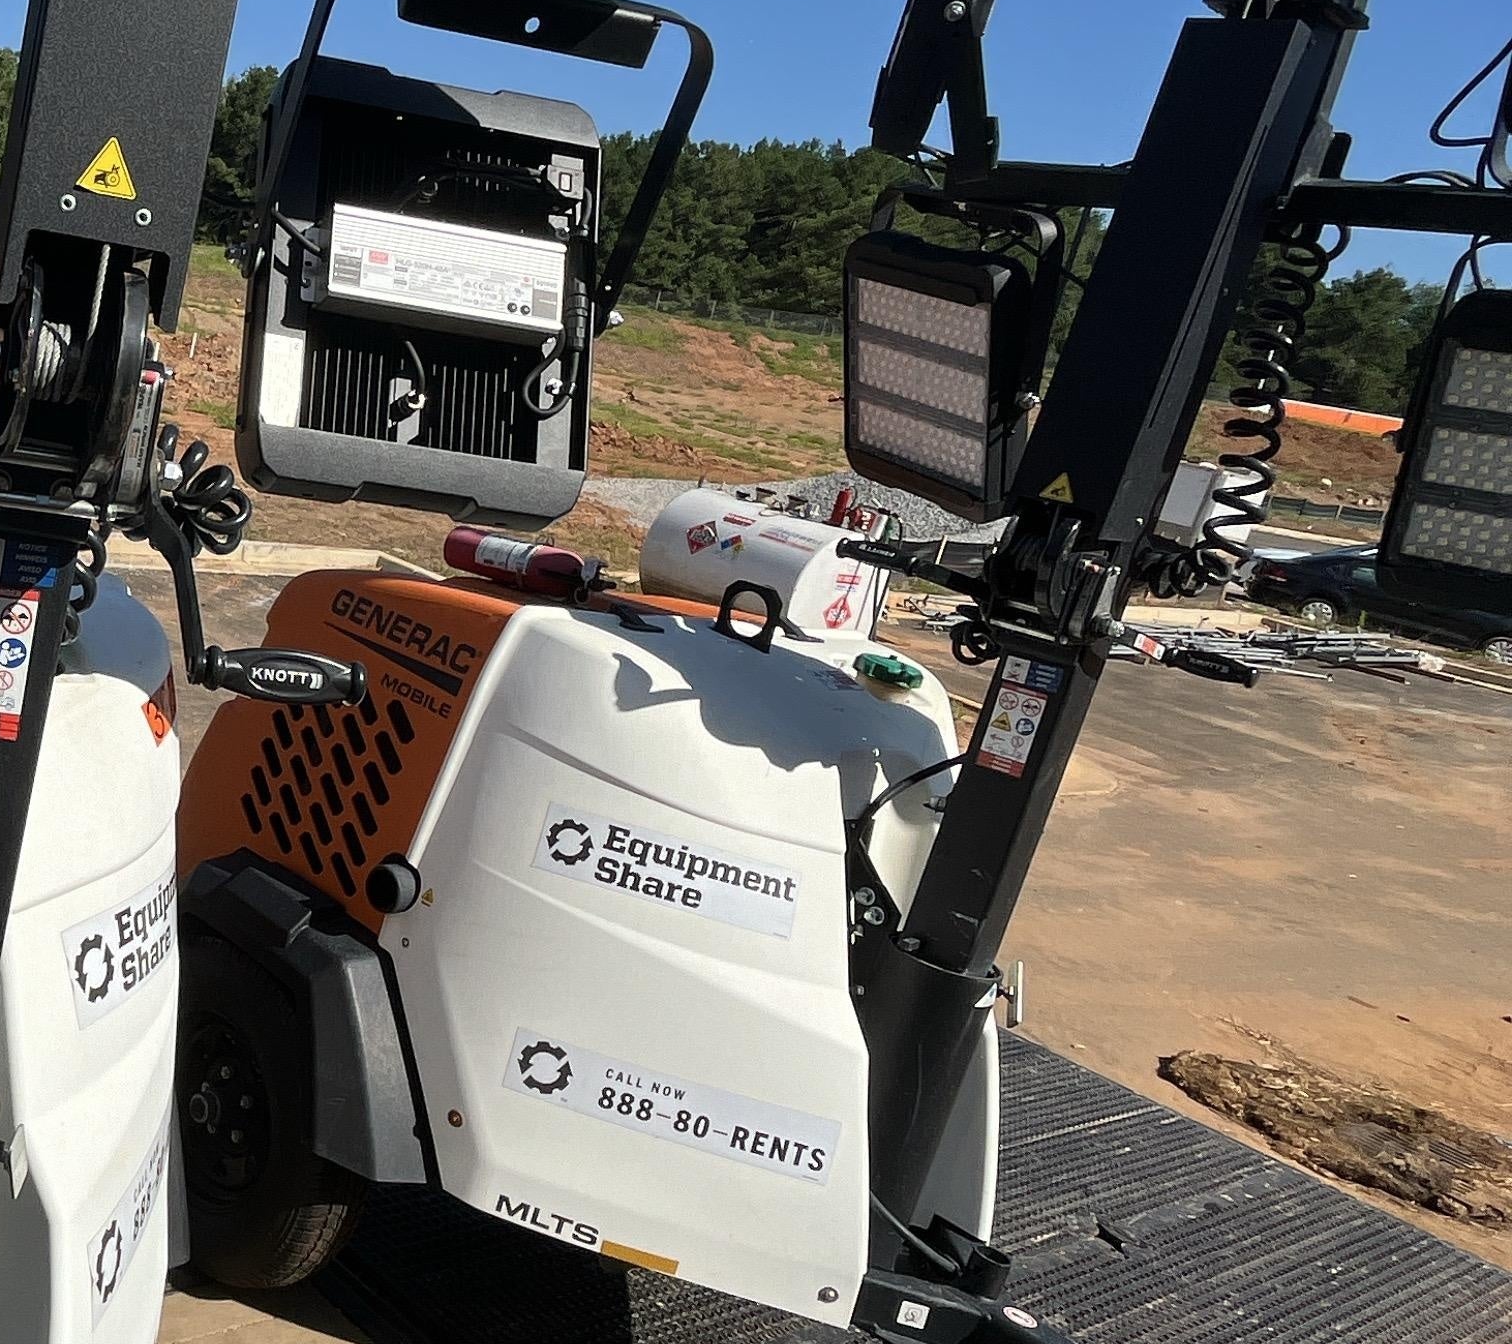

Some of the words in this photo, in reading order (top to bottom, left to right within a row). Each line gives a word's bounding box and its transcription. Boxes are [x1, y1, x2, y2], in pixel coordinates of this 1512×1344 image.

[330, 588, 477, 675] GENERAC
[251, 667, 309, 685] KNOTT
[380, 672, 452, 719] MOBILE
[594, 856, 702, 909] Share
[603, 824, 796, 902] Equipment
[121, 925, 172, 991] Share
[605, 1068, 643, 1089] CALL
[651, 1081, 688, 1101] NOW
[597, 1087, 826, 1173] 888-80-RENTS
[494, 1193, 599, 1246] MLTS
